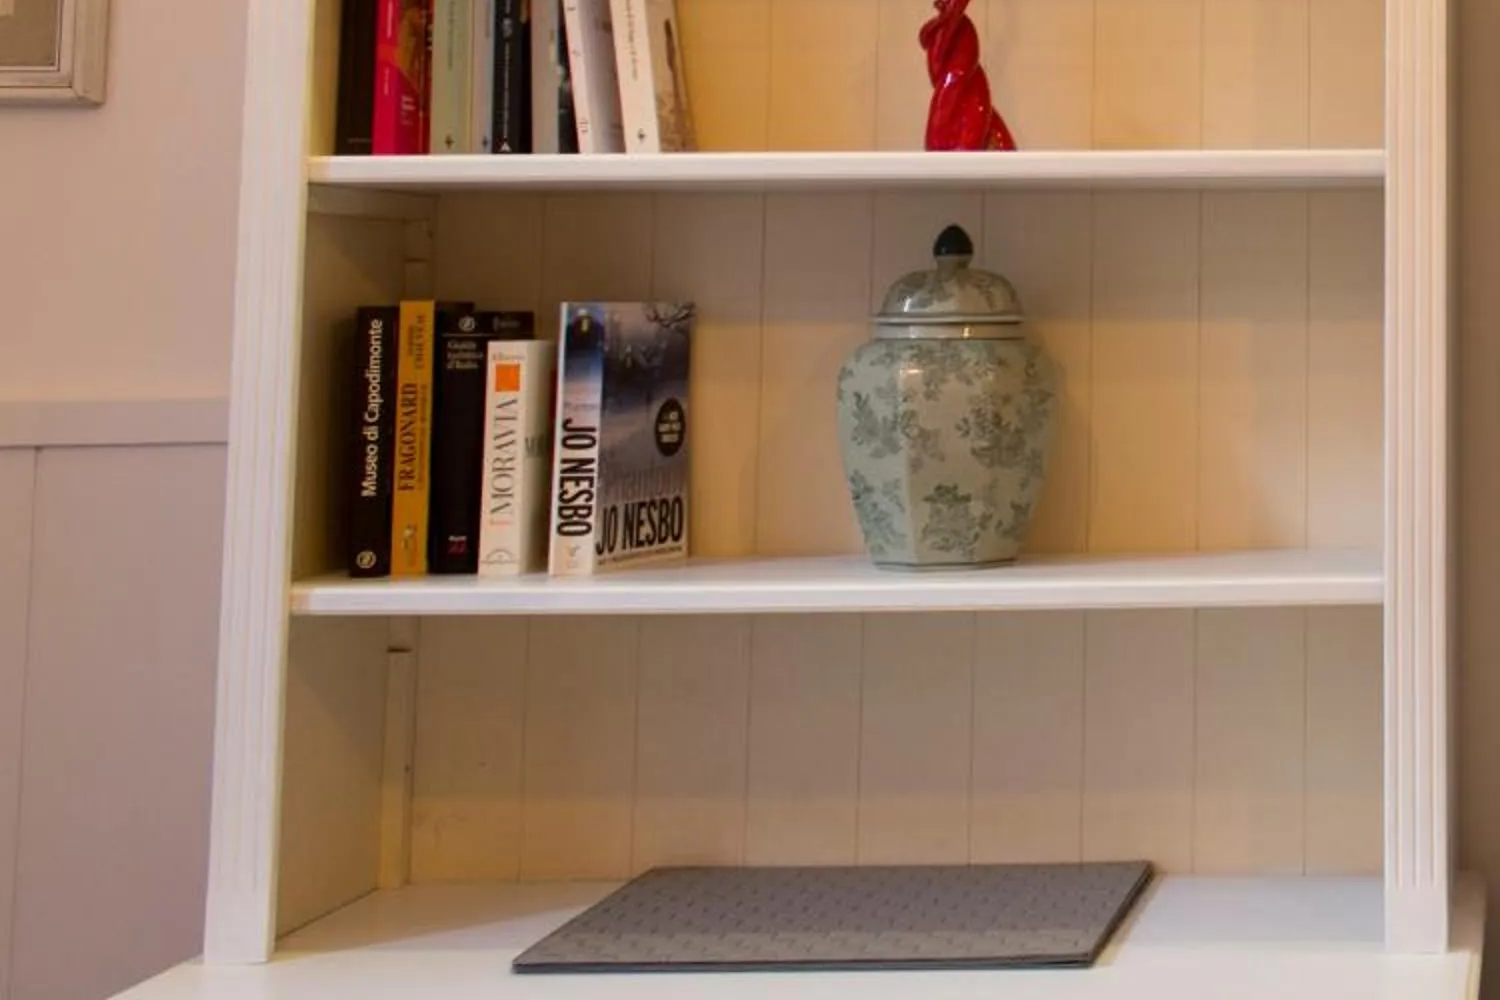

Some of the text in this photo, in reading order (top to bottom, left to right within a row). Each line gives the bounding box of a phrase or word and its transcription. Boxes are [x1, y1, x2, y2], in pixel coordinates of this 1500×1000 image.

[361, 319, 384, 497] Museo di Capodimonte
[398, 382, 418, 491] FRAGONARD
[490, 397, 518, 516] MORAVIA
[561, 418, 597, 450] JO
[596, 504, 618, 555] JO
